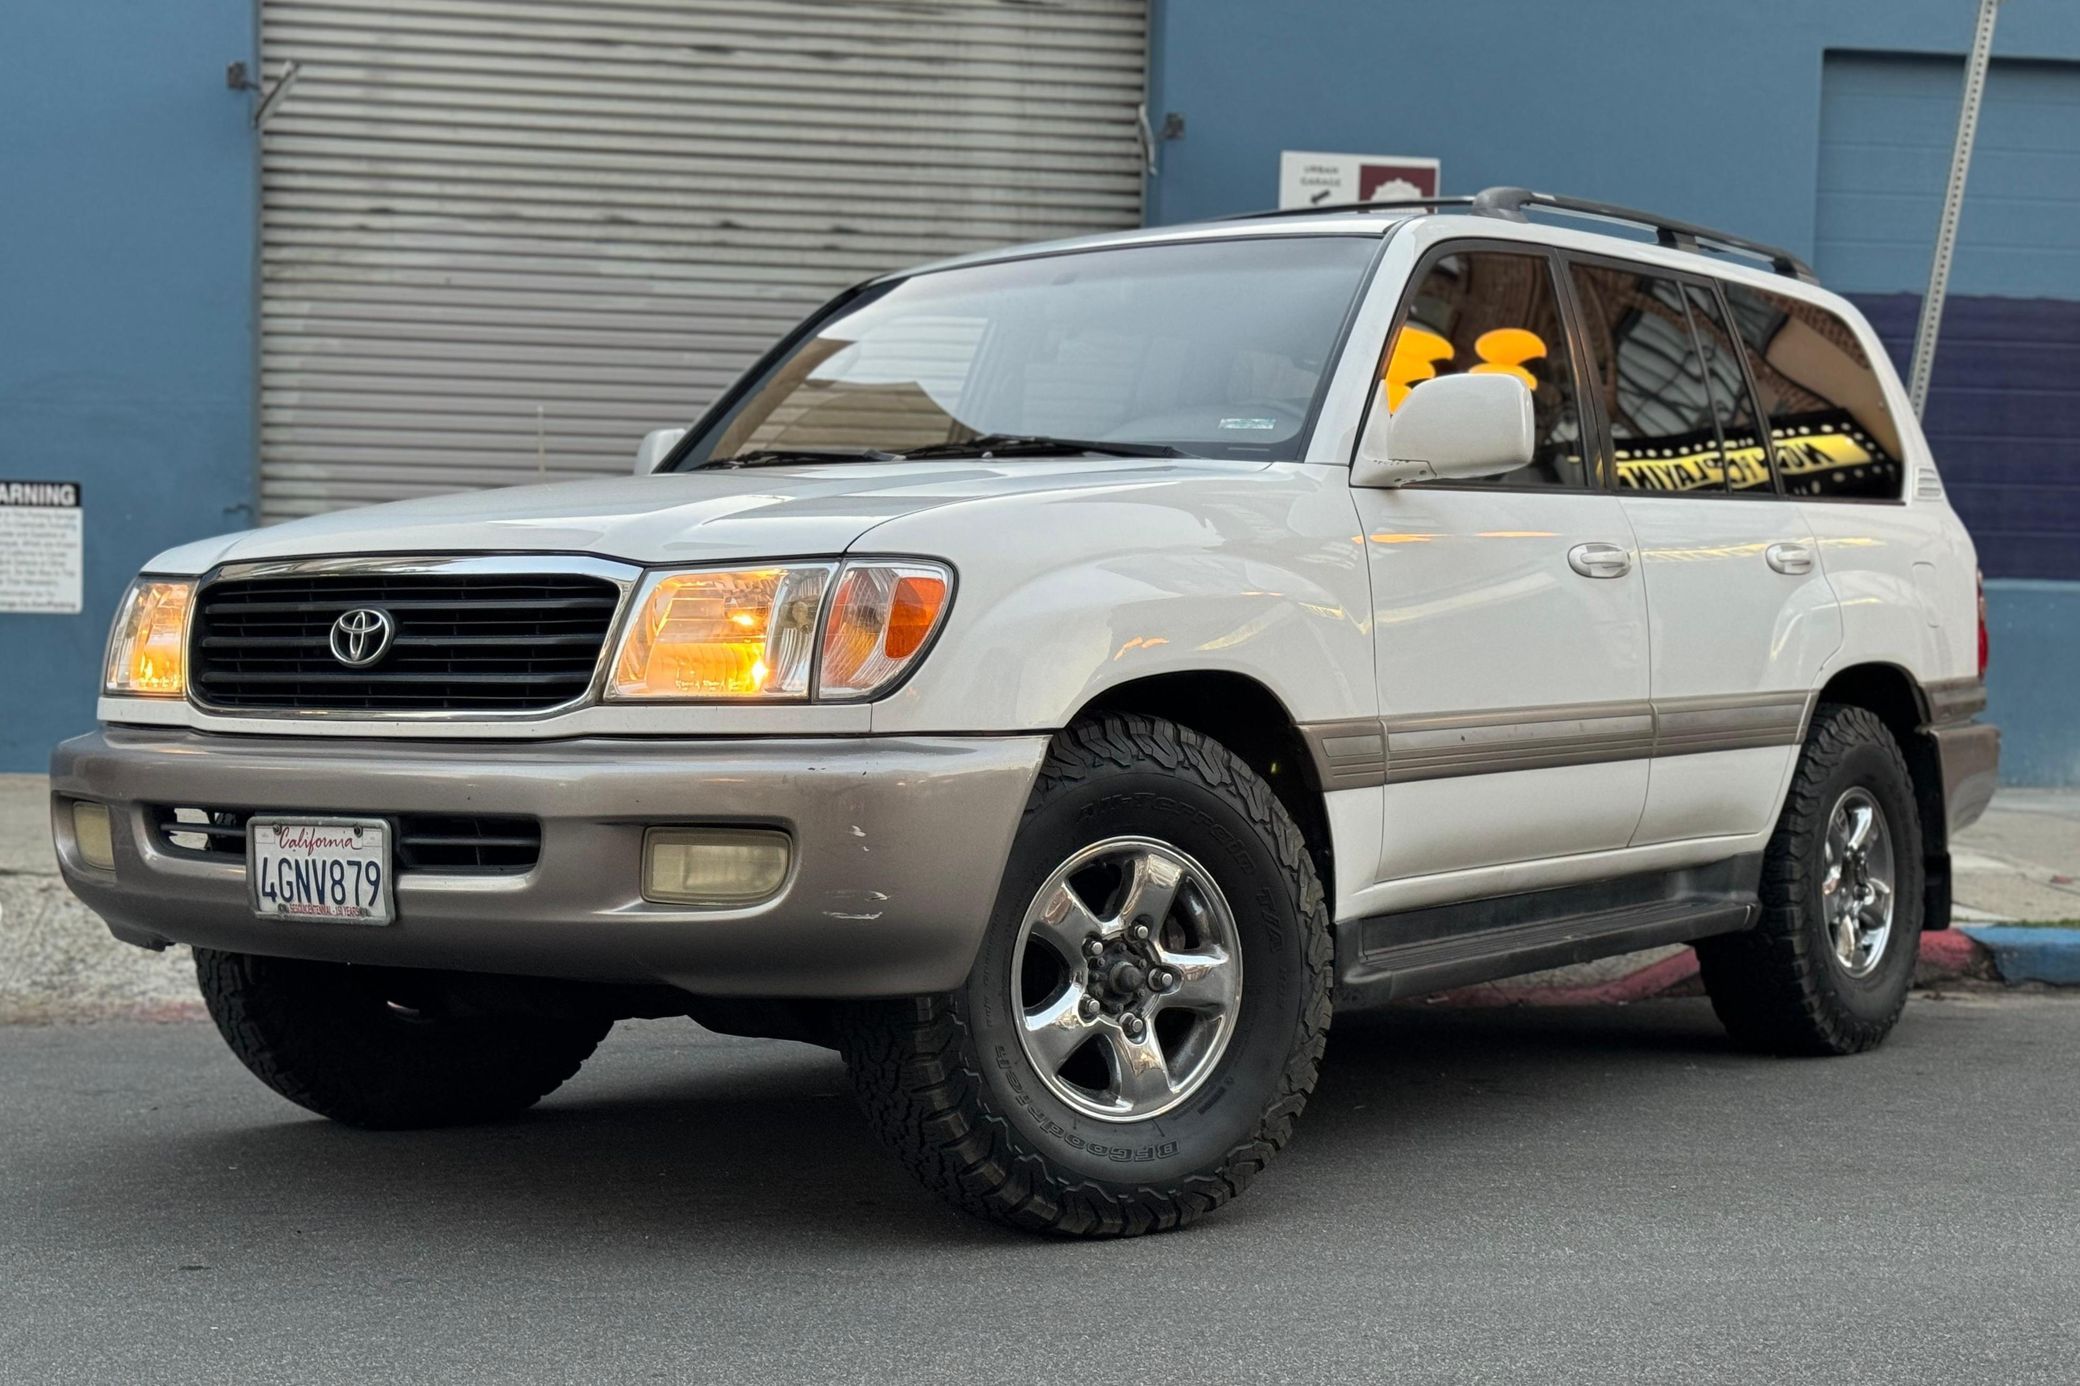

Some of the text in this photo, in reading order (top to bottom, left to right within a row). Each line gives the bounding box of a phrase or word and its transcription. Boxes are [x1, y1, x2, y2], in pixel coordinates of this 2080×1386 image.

[0, 483, 76, 506] ARNING
[279, 826, 362, 856] California
[262, 857, 381, 907] 4GNV879
